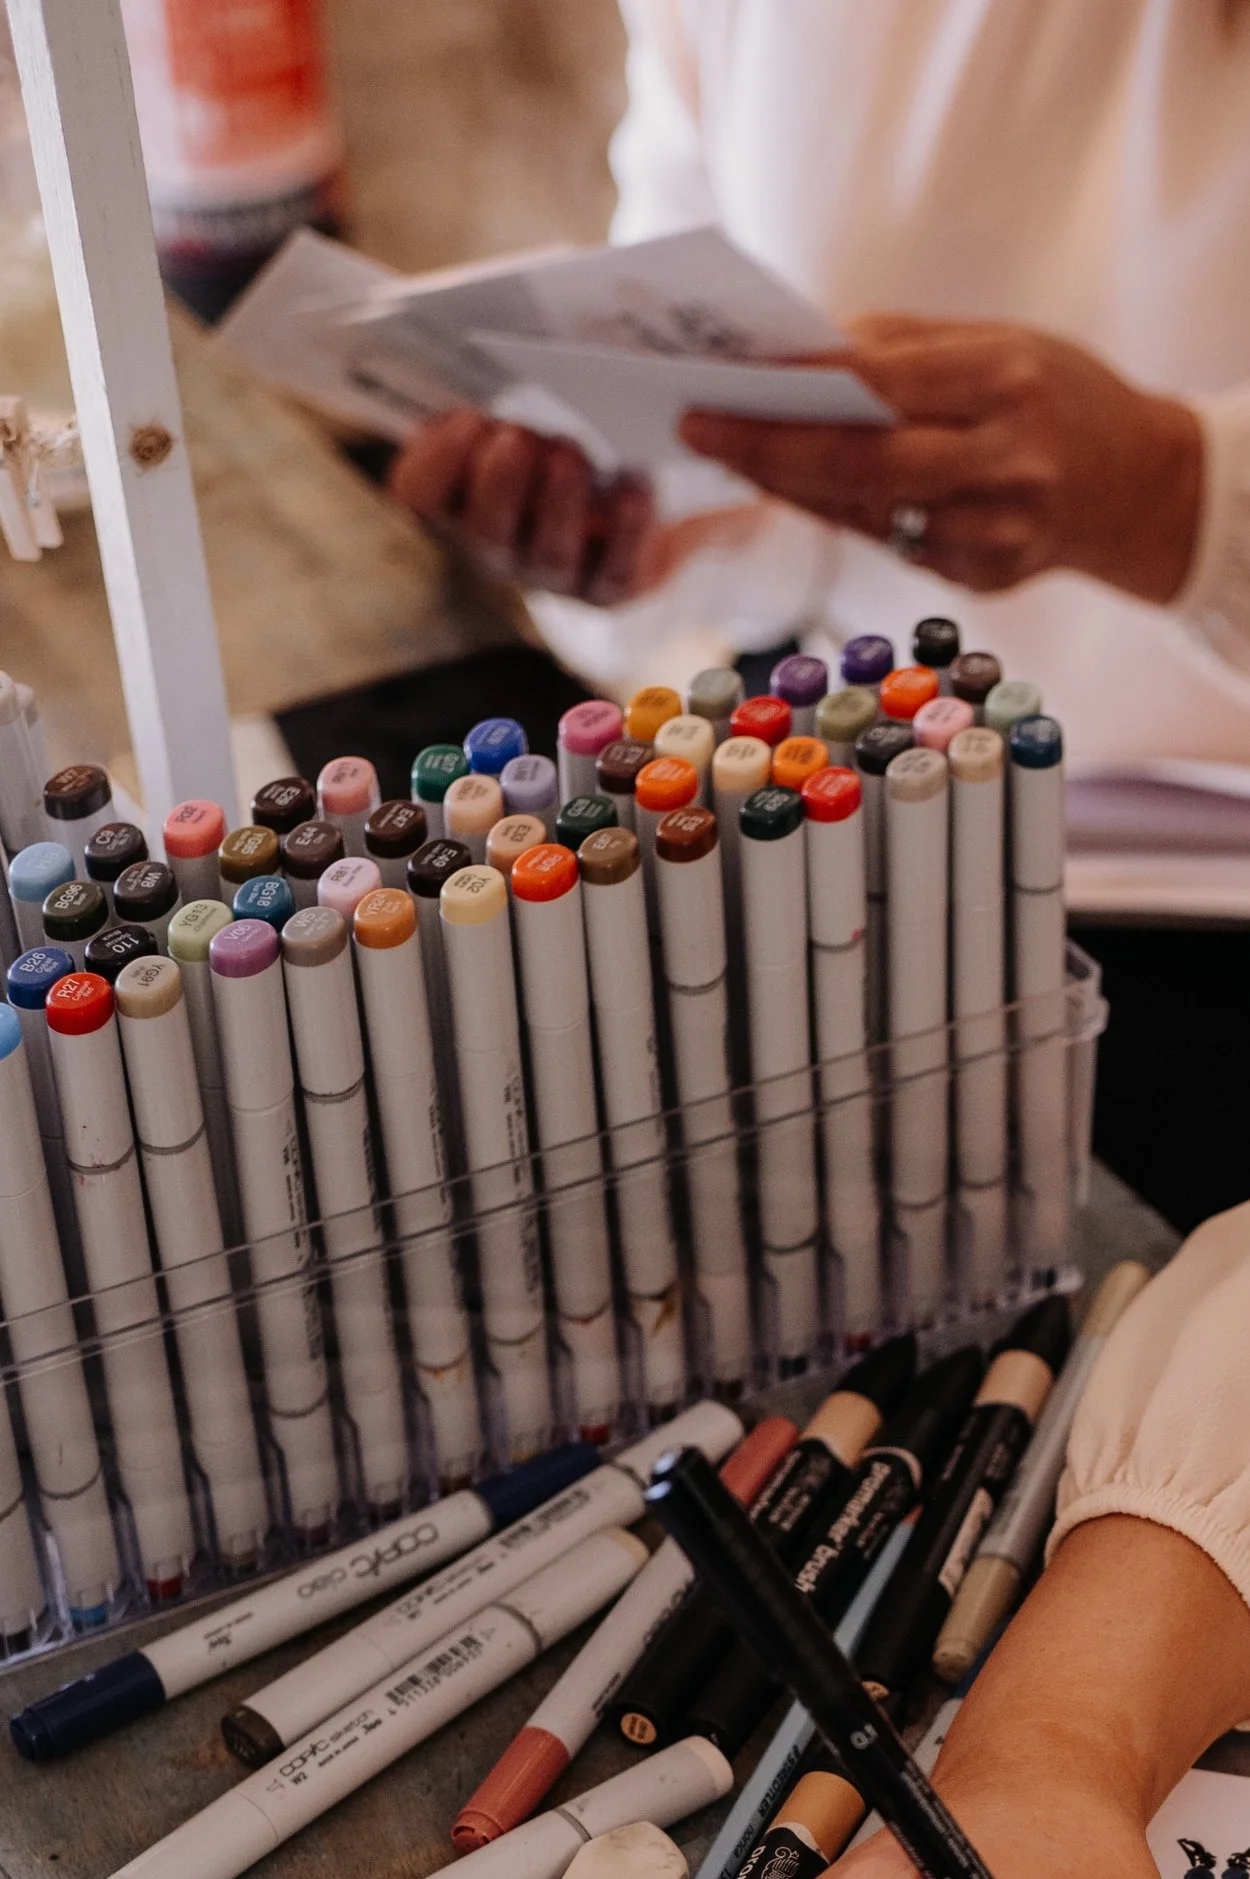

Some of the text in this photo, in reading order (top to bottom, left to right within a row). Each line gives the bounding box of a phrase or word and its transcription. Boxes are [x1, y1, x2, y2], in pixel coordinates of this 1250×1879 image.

[141, 872, 163, 888] W8
[54, 884, 83, 909] BG96
[257, 881, 280, 907] BG18
[179, 904, 208, 929] YG13
[112, 936, 139, 953] 110
[224, 925, 251, 941] V06
[20, 952, 46, 972] B26
[139, 964, 164, 987] YG91
[56, 978, 80, 999] R27
[279, 1740, 330, 1777] COPIC
[758, 1752, 798, 1819] STAEDTLER
[734, 1823, 755, 1860] norica
